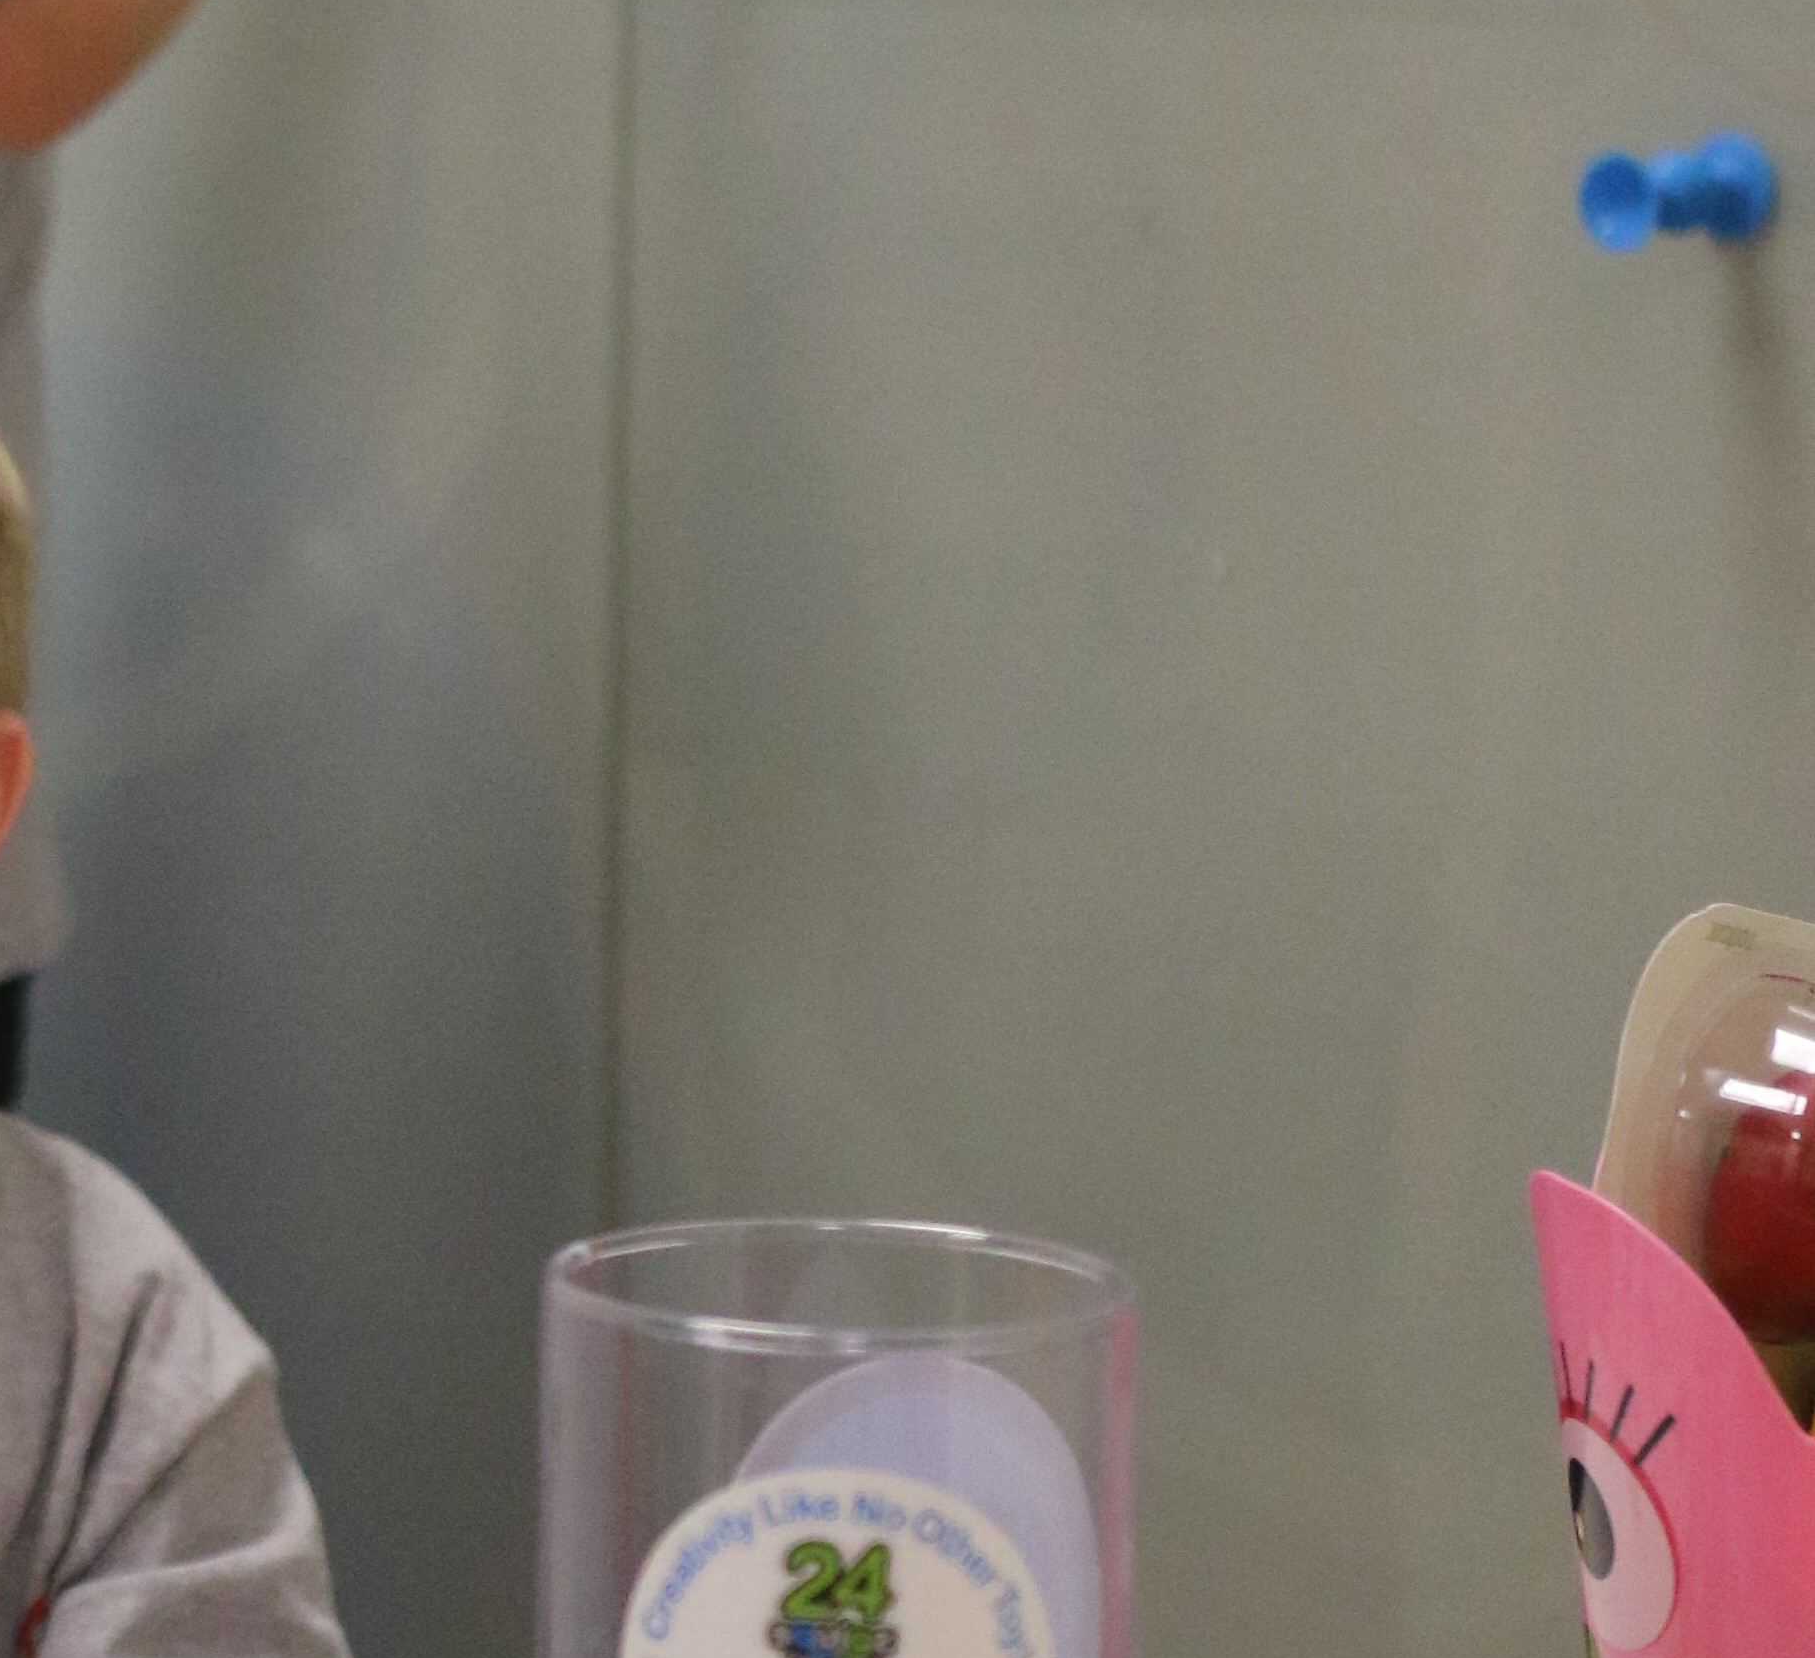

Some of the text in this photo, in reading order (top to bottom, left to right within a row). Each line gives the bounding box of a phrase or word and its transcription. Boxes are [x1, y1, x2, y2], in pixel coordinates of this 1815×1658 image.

[760, 1490, 840, 1526] Like
[851, 1490, 908, 1531] No
[780, 1538, 894, 1620] 24
